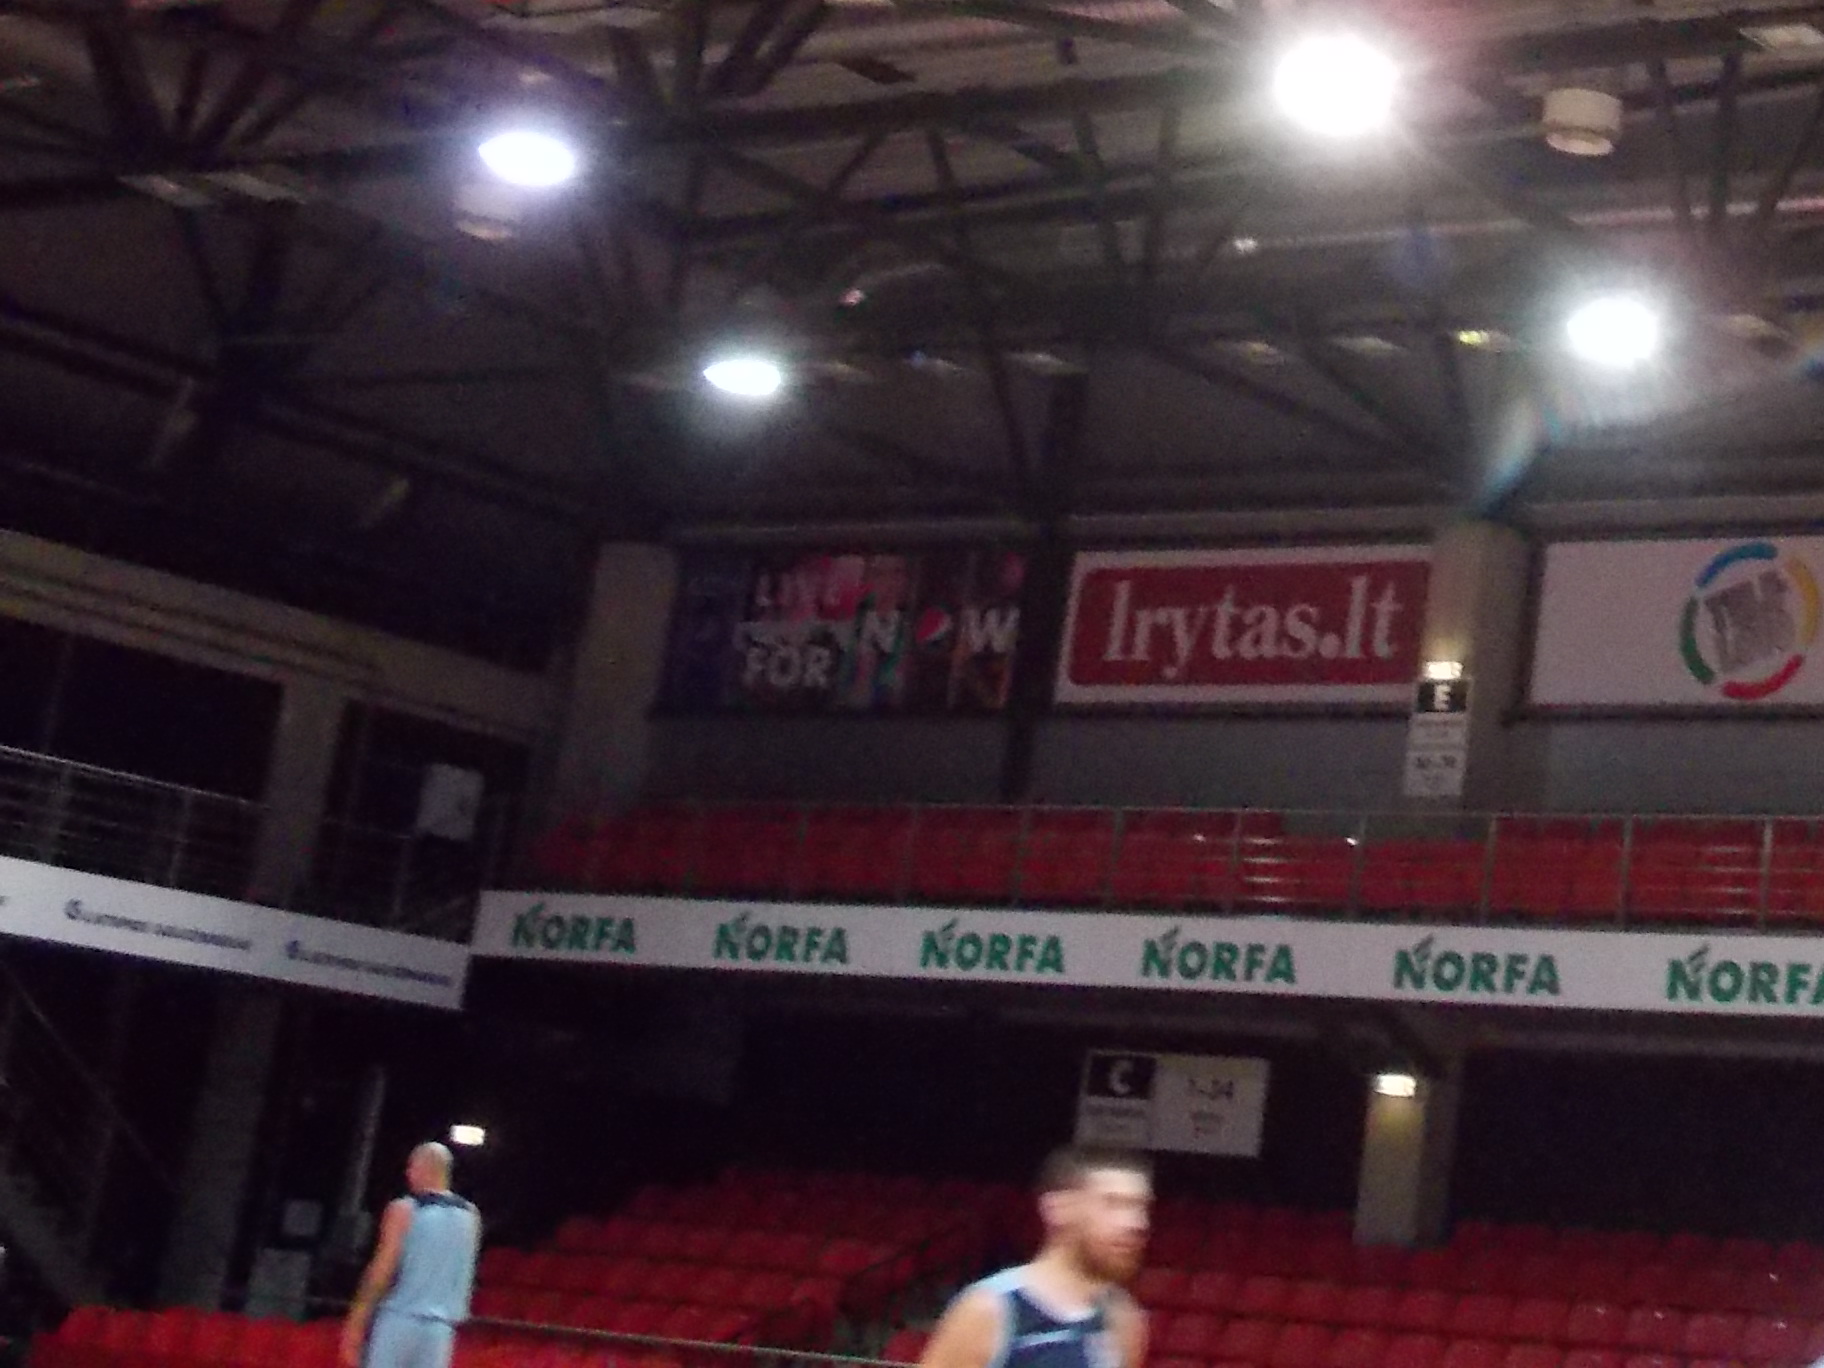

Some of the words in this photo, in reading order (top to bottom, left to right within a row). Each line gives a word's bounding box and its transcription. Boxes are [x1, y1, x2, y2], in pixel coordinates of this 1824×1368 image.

[1433, 684, 1450, 711] E
[510, 904, 637, 954] NORFA
[712, 912, 848, 965] NORFA
[918, 918, 1066, 974] NORFA
[1139, 926, 1297, 984] NORFA
[1392, 934, 1560, 996] NORFA
